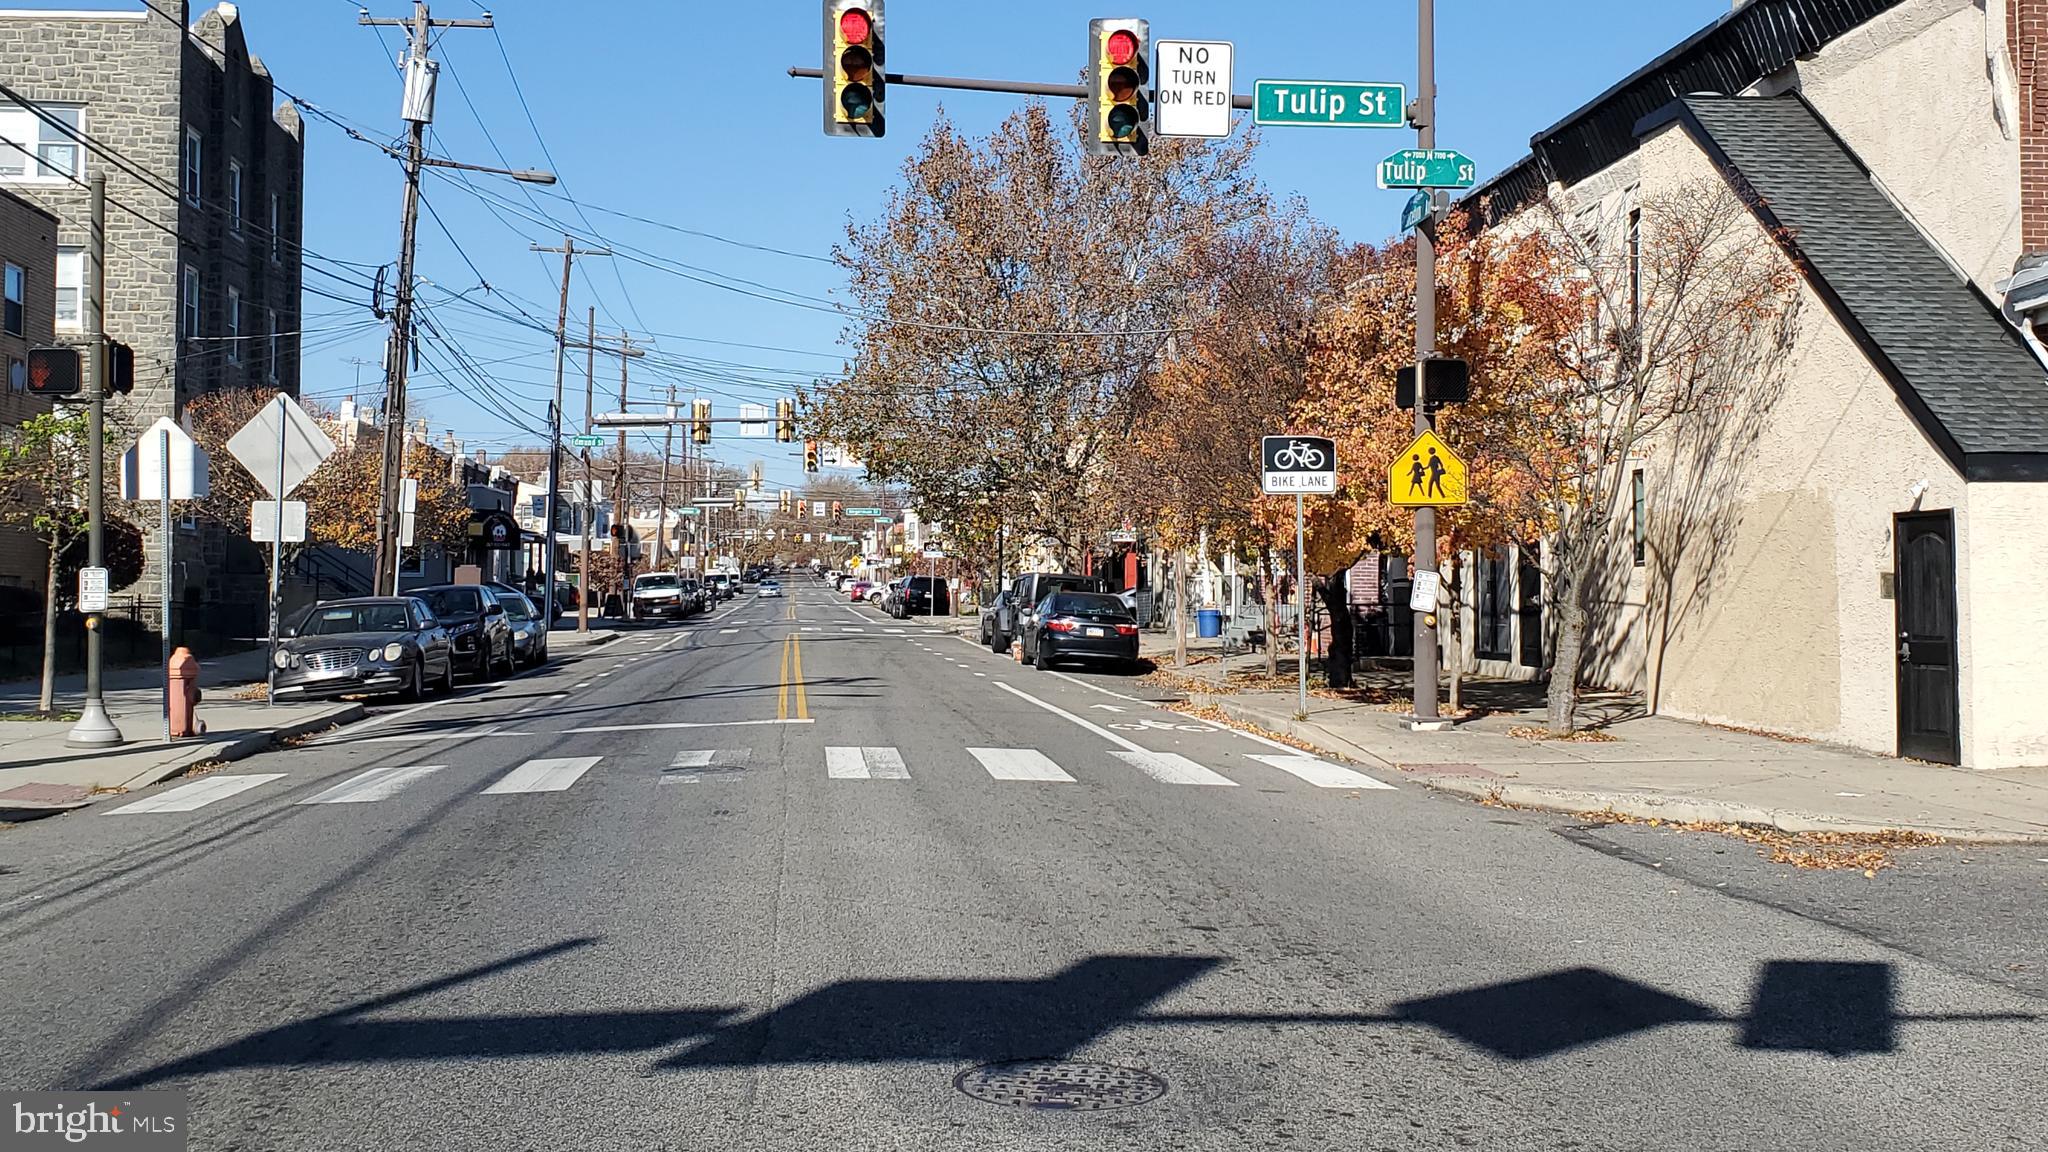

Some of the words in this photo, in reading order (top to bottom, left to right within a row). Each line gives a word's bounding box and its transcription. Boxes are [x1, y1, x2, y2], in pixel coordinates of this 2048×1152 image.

[1179, 47, 1209, 64] NO
[1172, 70, 1215, 85] TURN
[1160, 90, 1182, 104] ON
[1193, 91, 1226, 105] RED
[1274, 88, 1345, 121] Tulip
[1358, 91, 1387, 116] St
[1384, 160, 1426, 184] Tulip
[1458, 164, 1474, 181] St
[1271, 476, 1295, 487] BIKE
[1301, 476, 1328, 487] LANE
